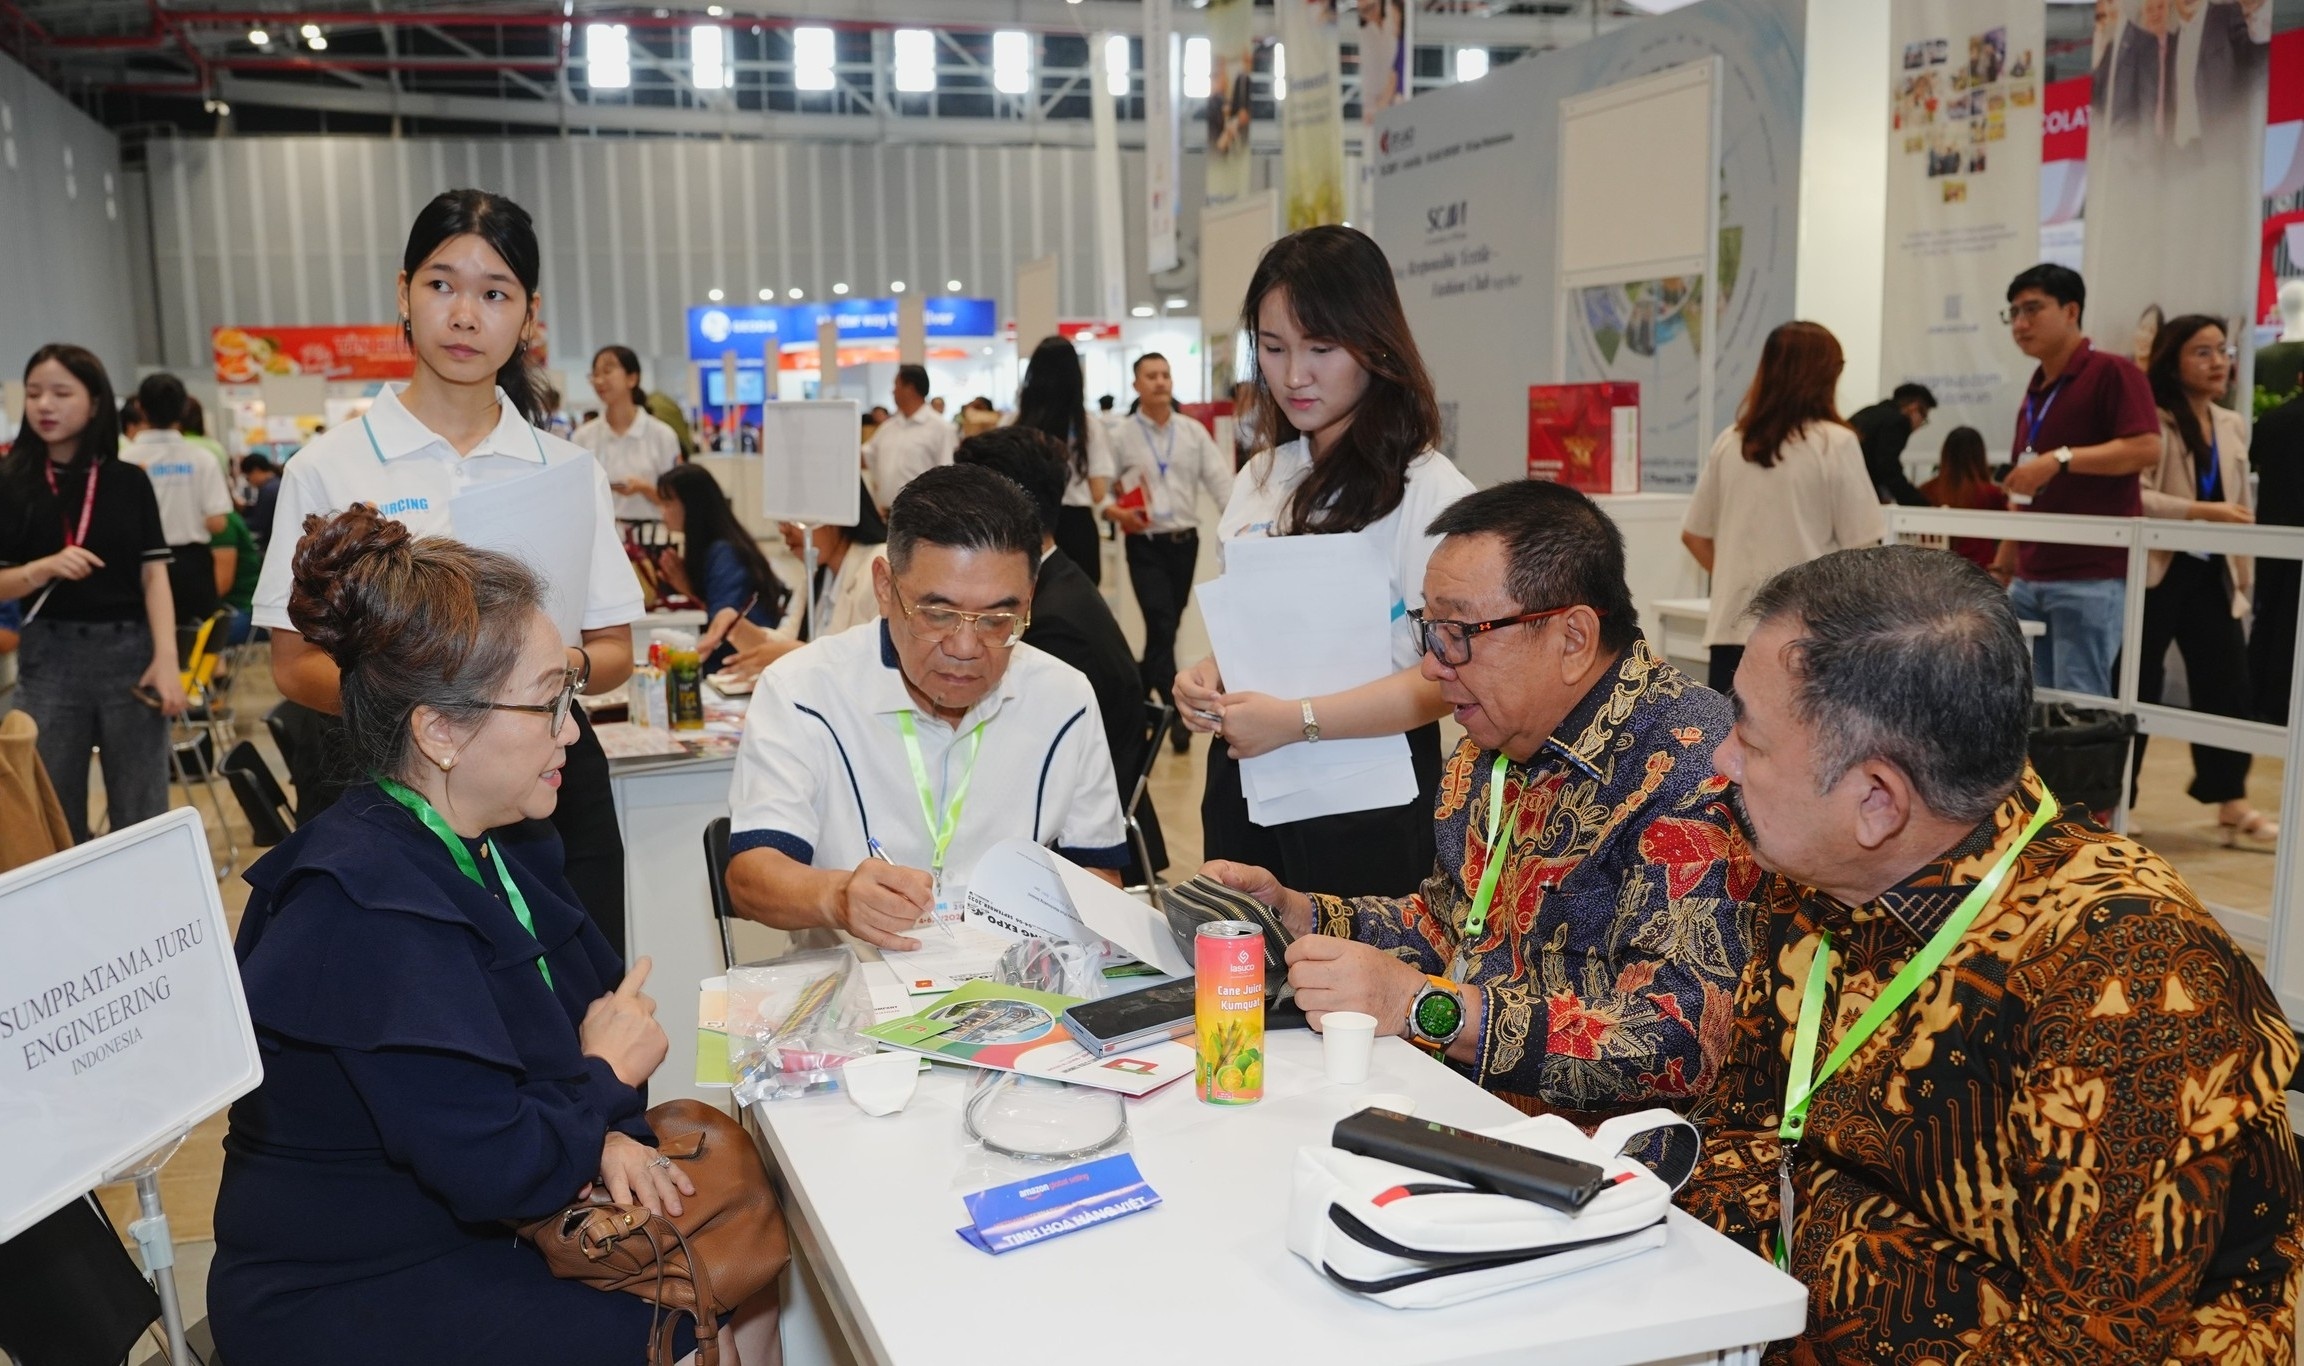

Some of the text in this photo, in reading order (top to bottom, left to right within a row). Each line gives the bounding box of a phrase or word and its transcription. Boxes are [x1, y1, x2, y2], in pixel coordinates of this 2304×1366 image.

[380, 498, 428, 515] URCING
[988, 915, 1018, 934] EXPO
[0, 919, 204, 1040] SUMPRATAMA JURU
[1217, 983, 1262, 996] Cane Juice
[1221, 997, 1260, 1012] Kumquat
[21, 974, 172, 1072] ENGINEERING
[71, 1026, 143, 1076] INDONESIA
[1019, 1184, 1049, 1198] amazon
[1002, 1228, 1043, 1246] TINH
[1039, 1218, 1074, 1236] HOA
